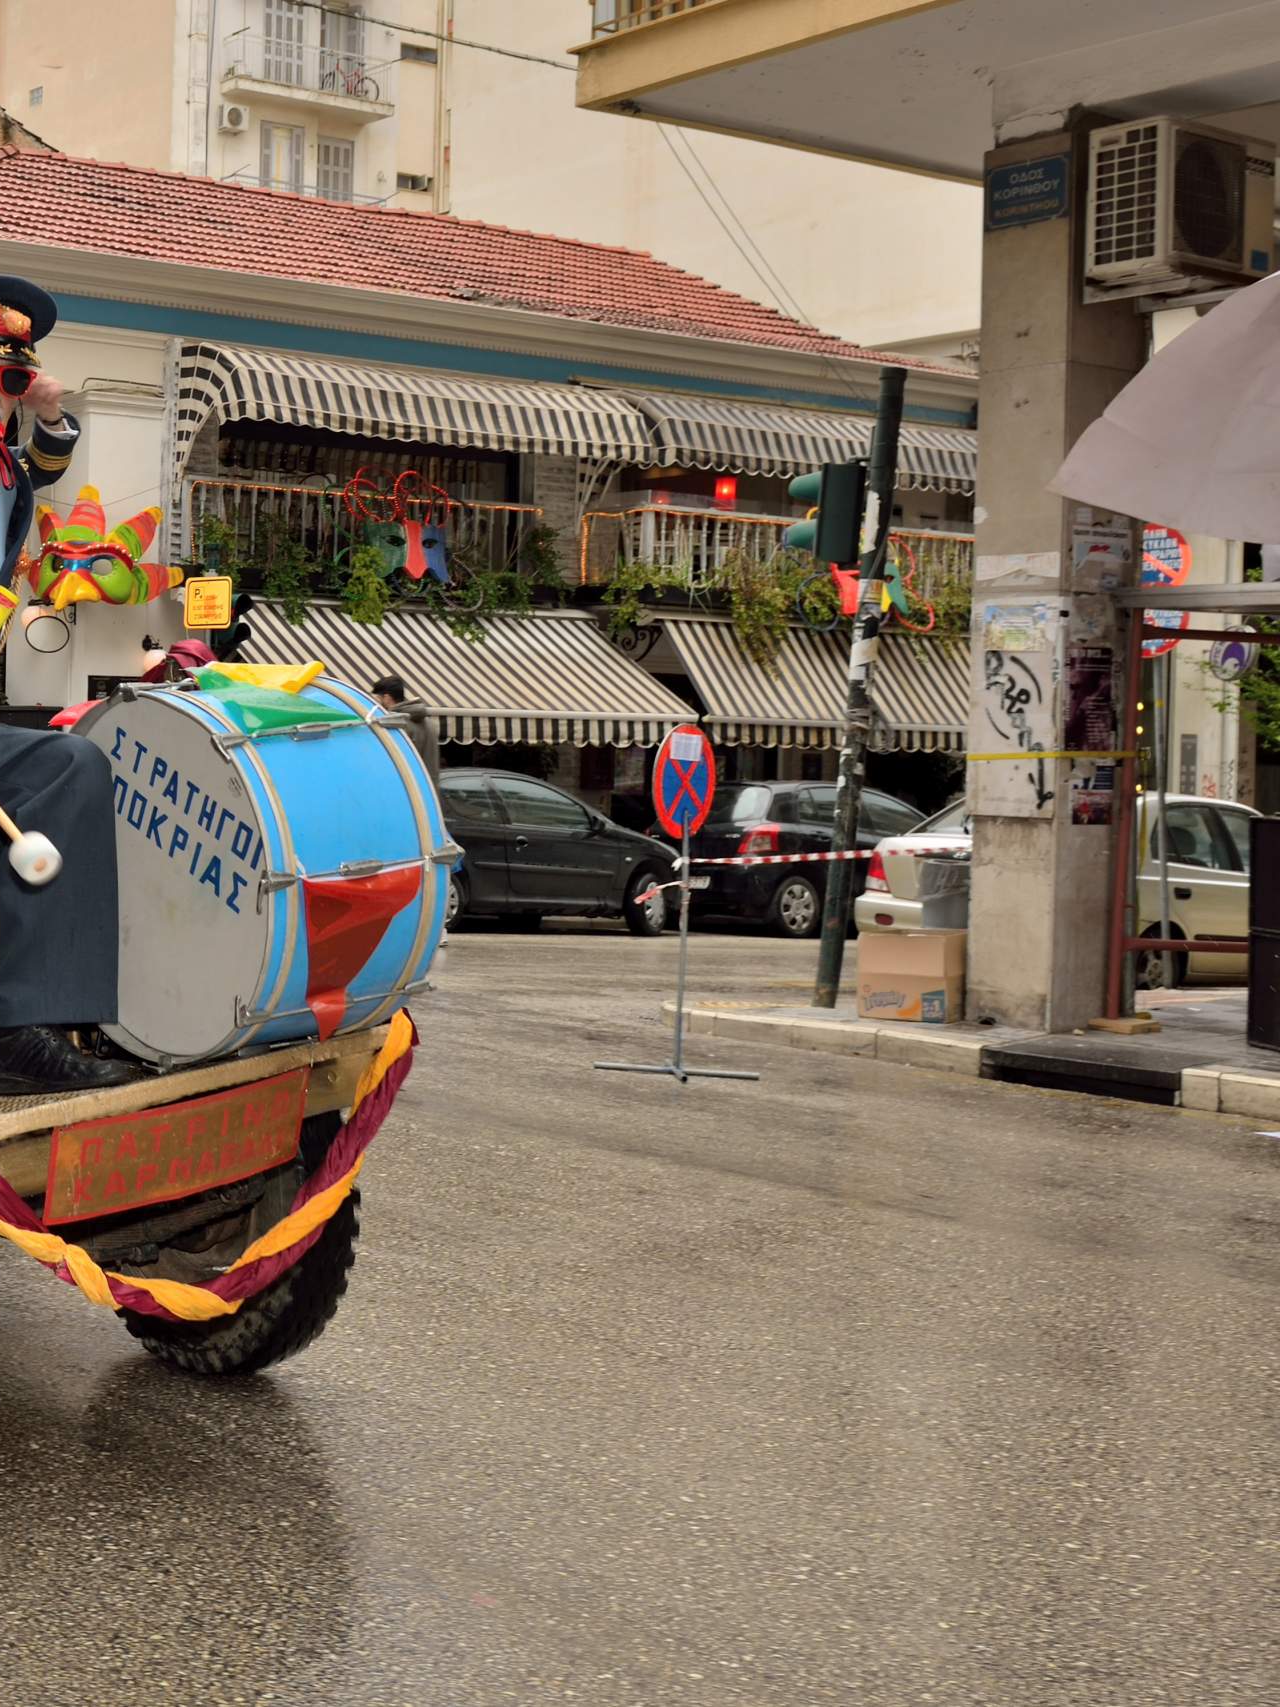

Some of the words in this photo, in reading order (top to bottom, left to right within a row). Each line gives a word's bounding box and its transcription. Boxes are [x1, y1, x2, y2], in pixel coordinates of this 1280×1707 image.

[993, 178, 1060, 200] ΚΟΡΙΝΘΟΥ
[1009, 168, 1045, 184] ΟΔΟΣ
[110, 726, 264, 871] ΣΤΡΑΤΗΓΟΙ
[113, 774, 248, 914] ΠΟΚΡΙΑΣ
[80, 1089, 290, 1168] ΠΑΤΡΙΝΟ
